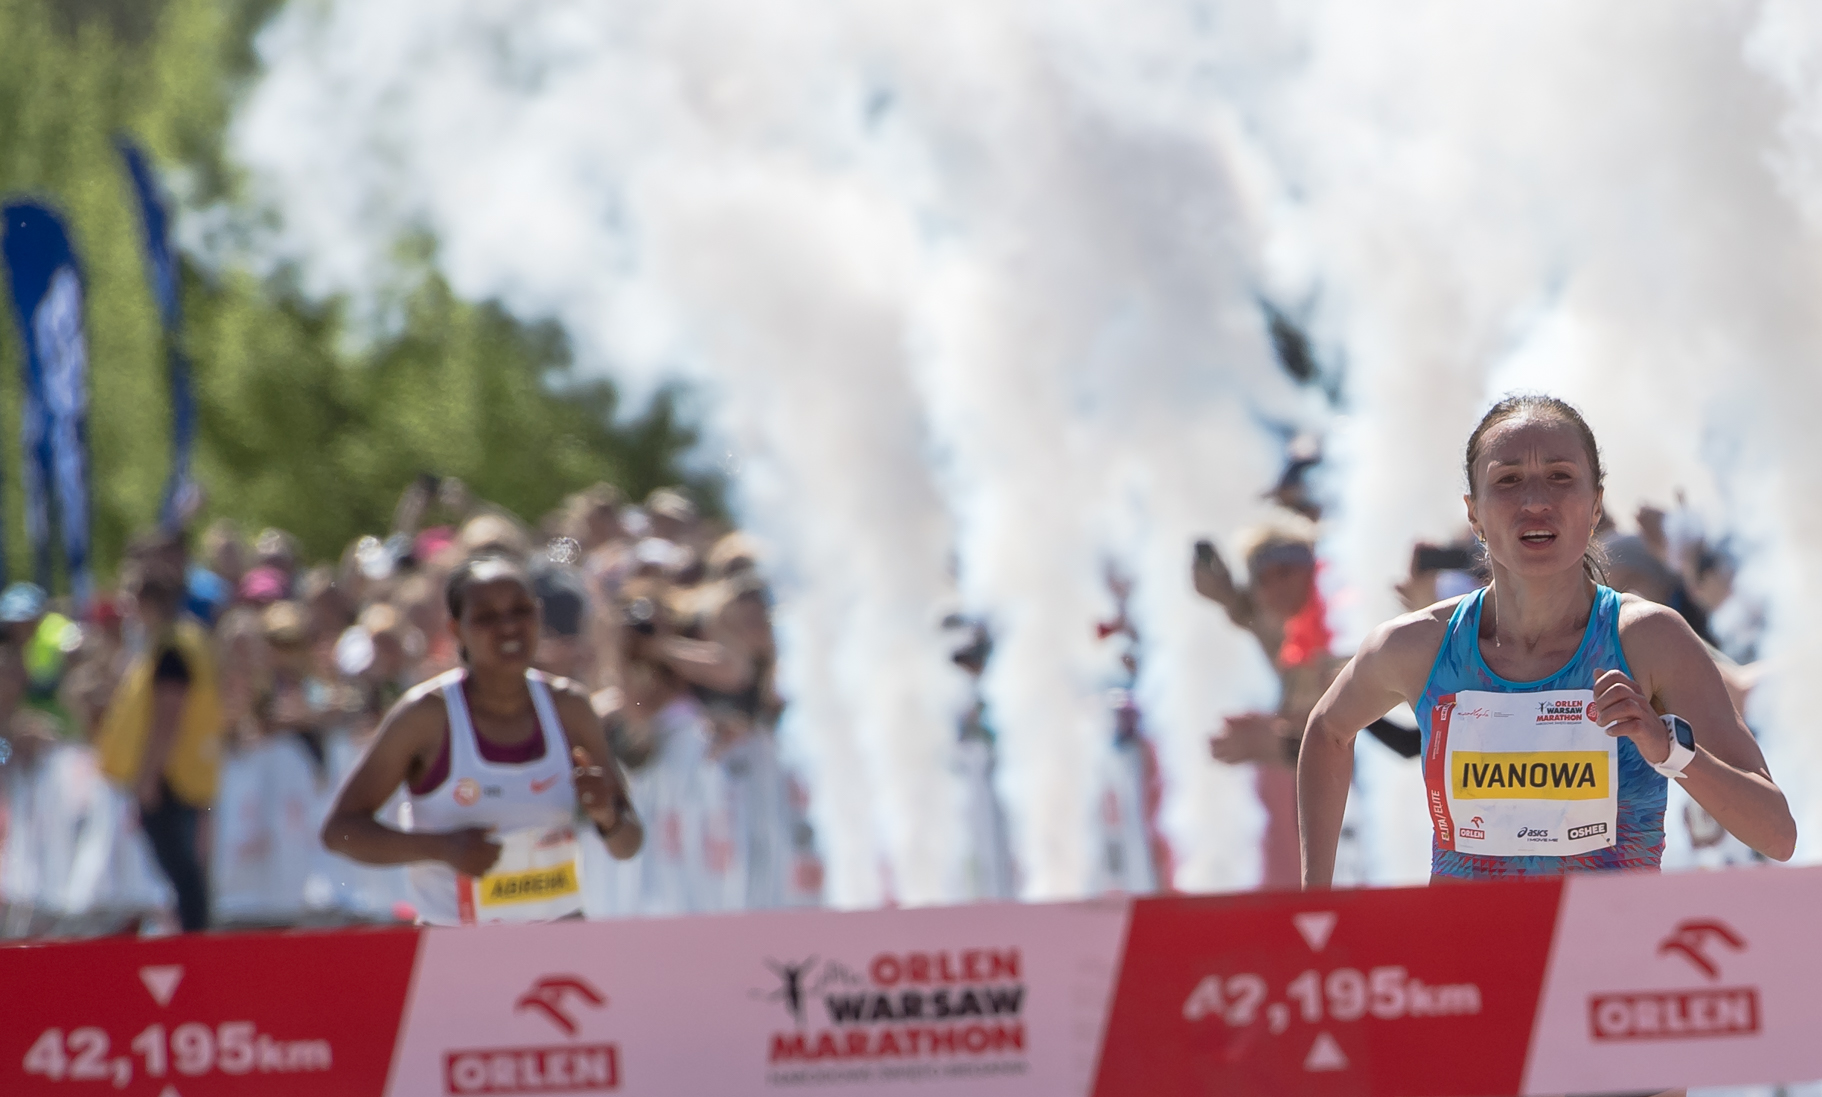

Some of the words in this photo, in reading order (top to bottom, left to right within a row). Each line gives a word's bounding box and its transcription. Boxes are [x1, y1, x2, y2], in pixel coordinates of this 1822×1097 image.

[1536, 714, 1583, 722] MARATHON
[1462, 762, 1596, 788] IVANOWA
[1460, 829, 1484, 839] ORLEN
[1570, 825, 1606, 839] OSHEE
[869, 946, 1023, 988] ORLEN
[825, 983, 1026, 1027] WARSAW
[1599, 996, 1749, 1035] ORLEN
[22, 1020, 333, 1090] 42,195km
[769, 1020, 1026, 1066] MARATHON
[452, 1052, 609, 1090] ORLEN
